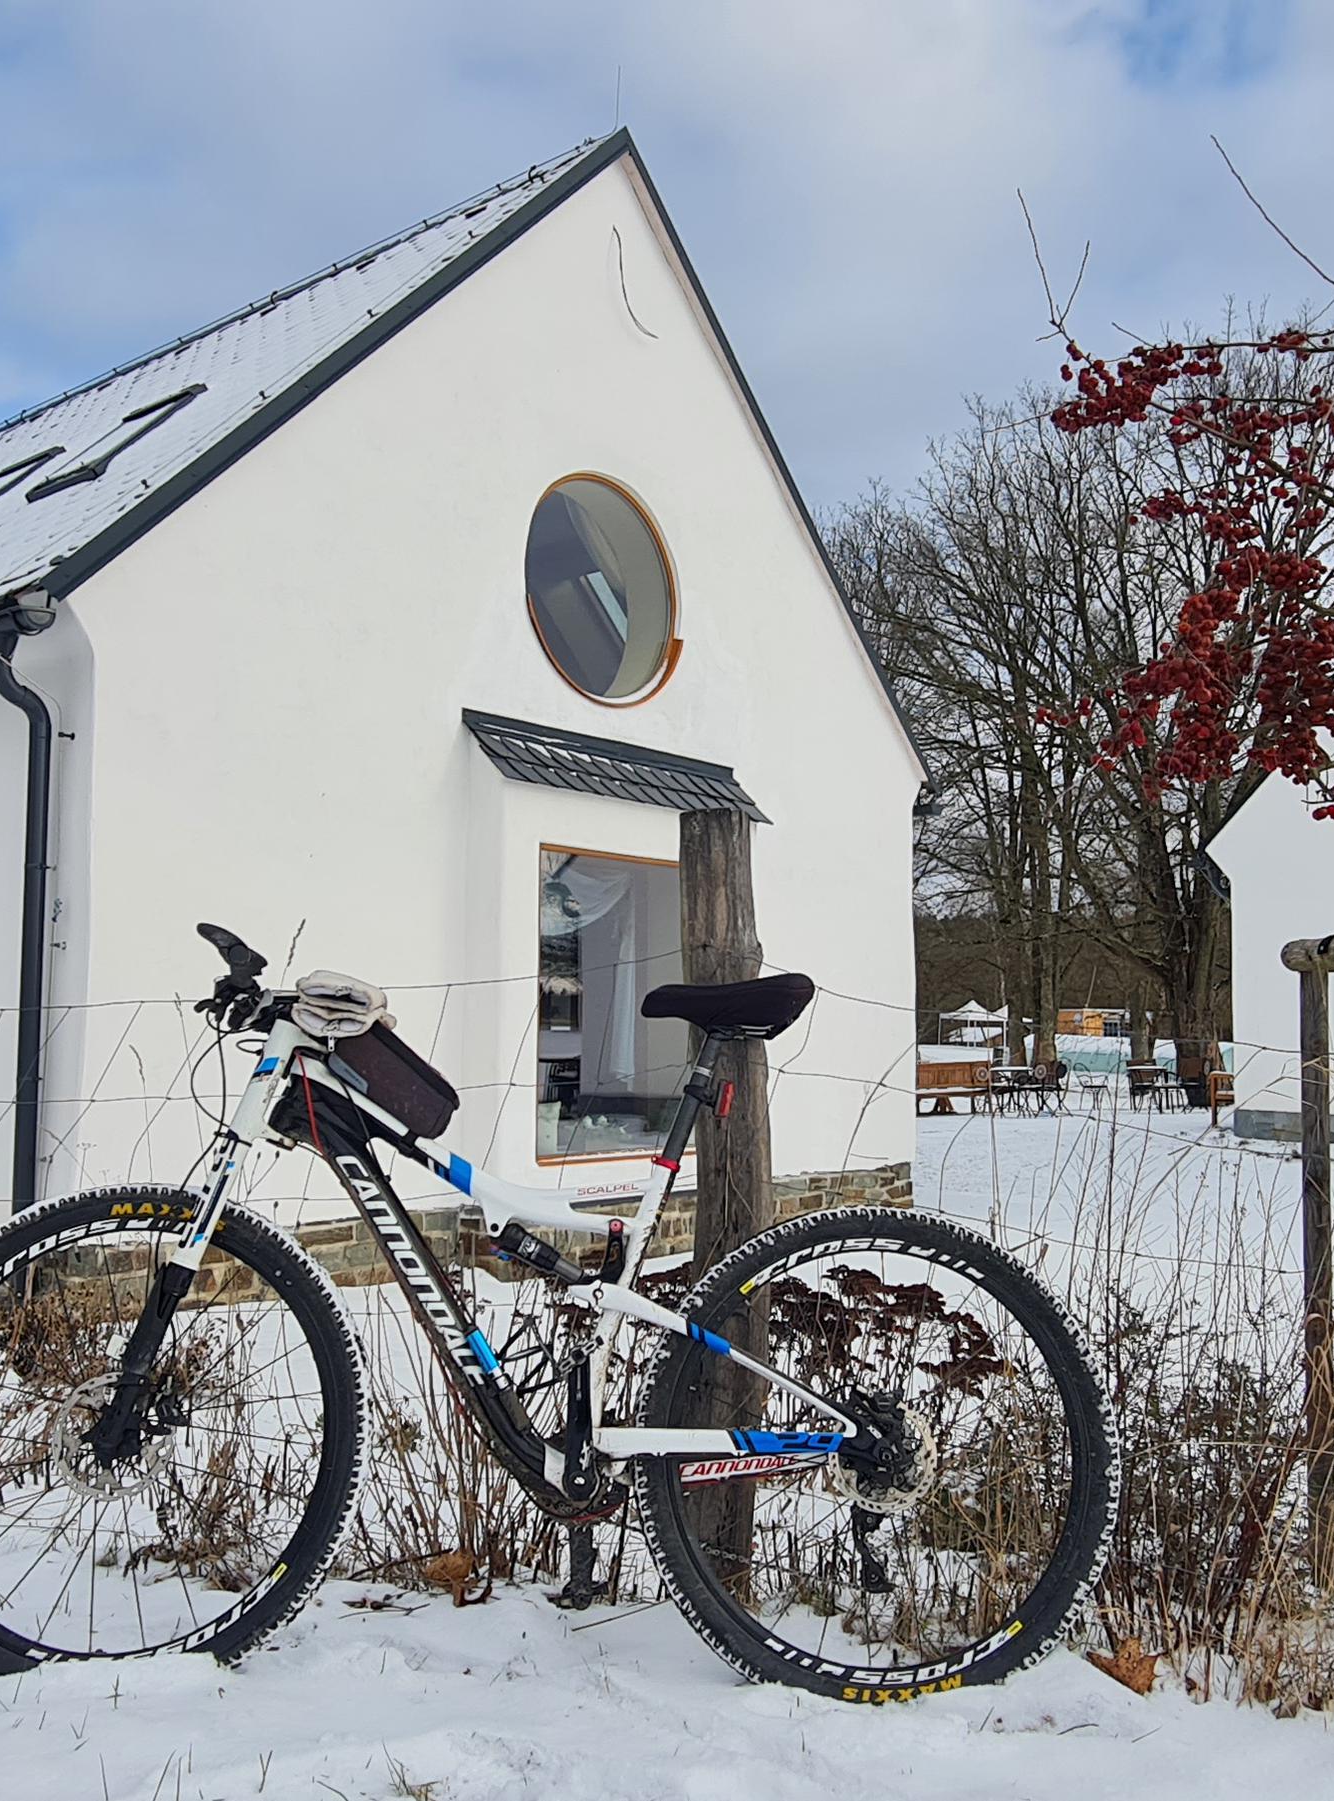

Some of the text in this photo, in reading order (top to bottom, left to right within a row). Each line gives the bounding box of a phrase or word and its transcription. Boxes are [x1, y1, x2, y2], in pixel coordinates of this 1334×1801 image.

[577, 1183, 639, 1196] SCALPEL
[110, 1202, 227, 1232] MAXXS
[777, 1432, 844, 1453] 29
[842, 1674, 962, 1702] MAXXIS
